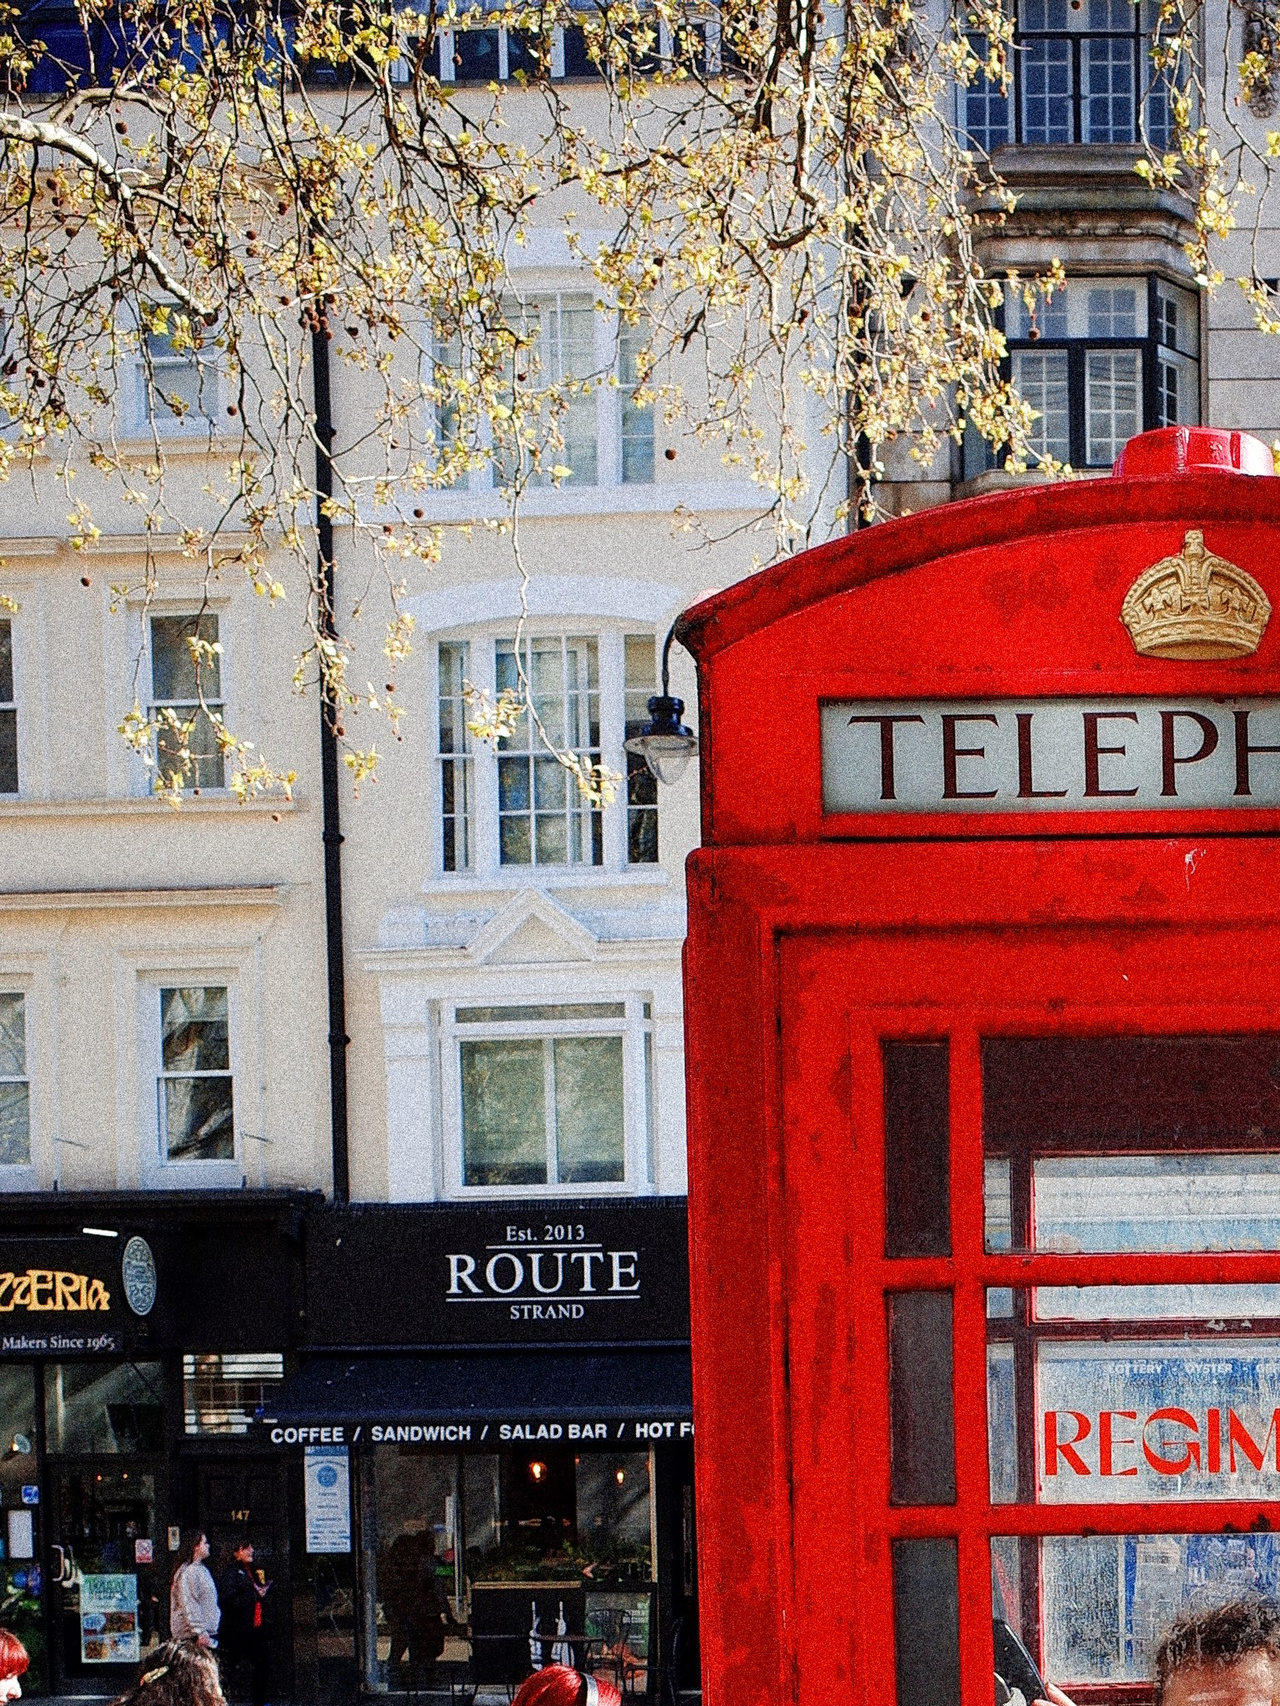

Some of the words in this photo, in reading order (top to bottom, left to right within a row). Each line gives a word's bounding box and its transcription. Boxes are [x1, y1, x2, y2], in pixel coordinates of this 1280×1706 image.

[505, 1225, 538, 1242] Est.
[543, 1224, 586, 1241] 2013
[445, 1251, 641, 1294] ROUTE
[510, 1304, 585, 1320] STRAND
[2, 1335, 48, 1350] Makers
[49, 1334, 84, 1350] Since
[86, 1334, 116, 1351] 1965
[270, 1426, 345, 1444] COFFEE
[371, 1425, 472, 1442] SANDWICH
[499, 1423, 563, 1440] SALAD
[568, 1422, 608, 1440] BAR
[635, 1421, 675, 1439] HOT
[679, 1421, 694, 1438] F
